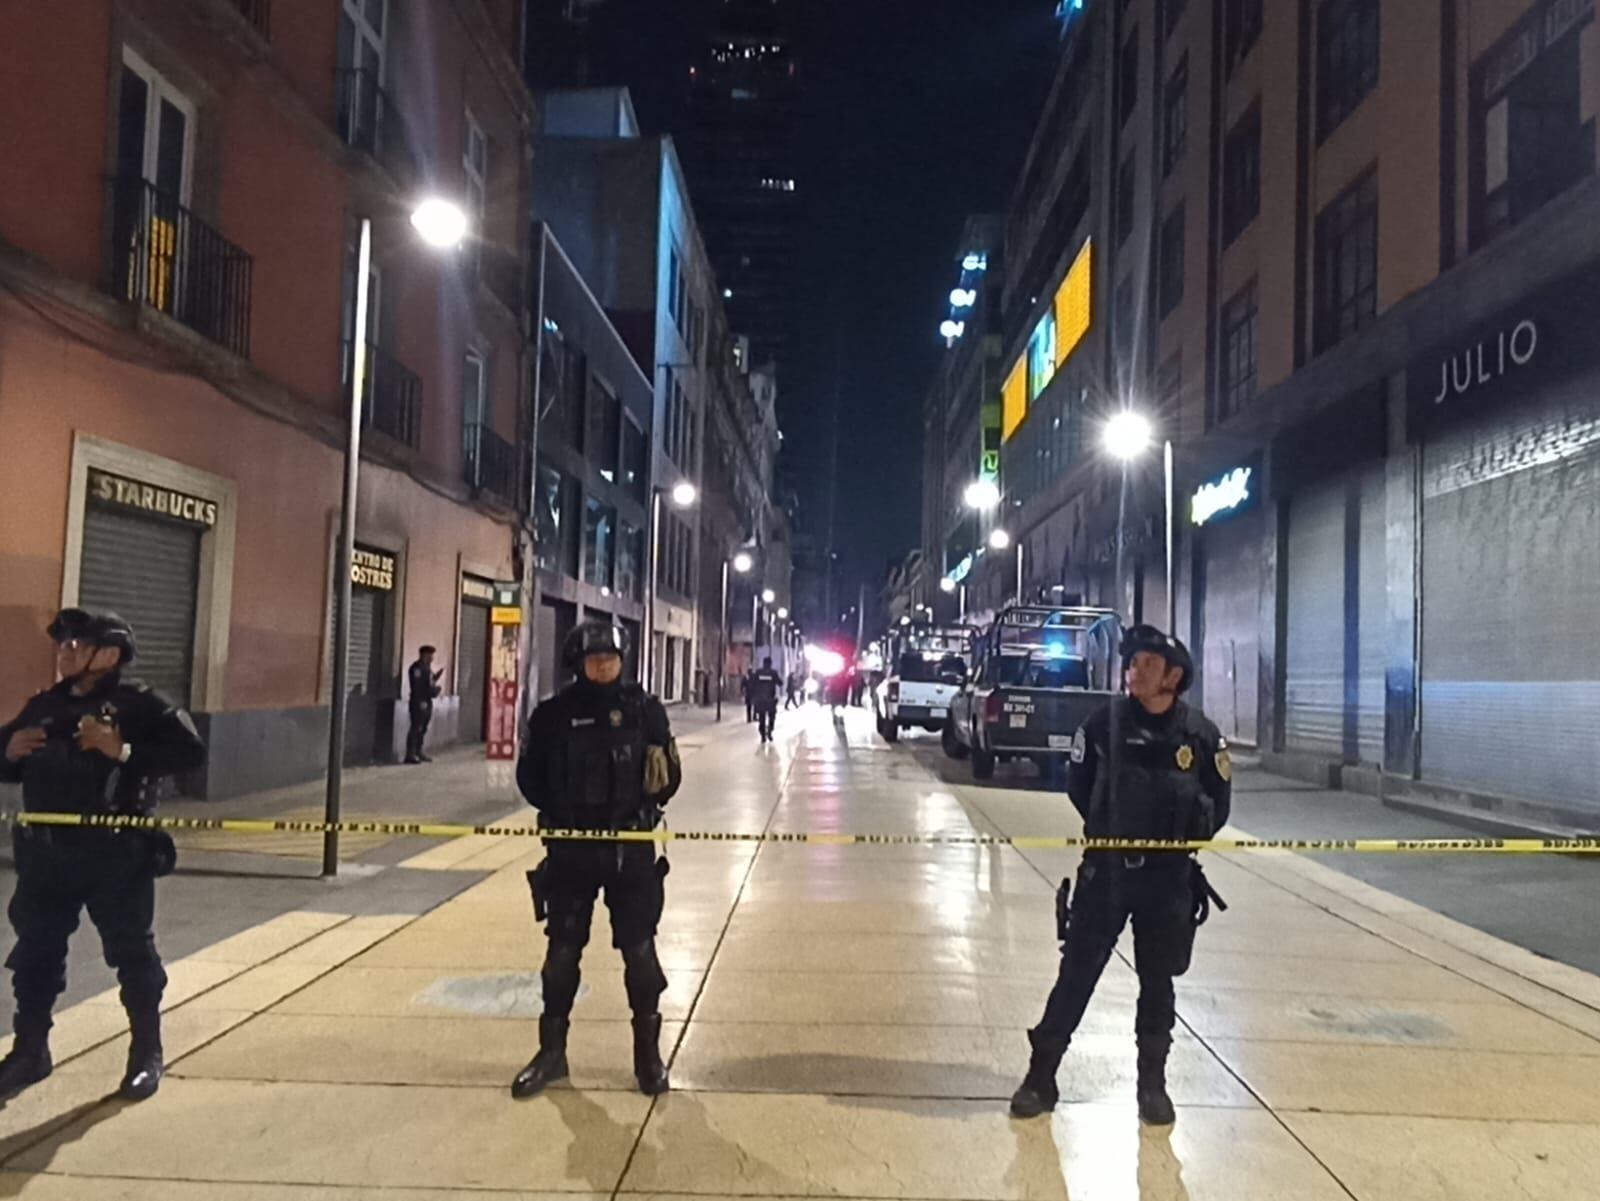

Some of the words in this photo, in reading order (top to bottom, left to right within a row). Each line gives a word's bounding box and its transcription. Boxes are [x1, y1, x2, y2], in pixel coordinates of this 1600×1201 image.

[1435, 319, 1537, 404] JULIO
[97, 474, 217, 525] STARBUCKS
[351, 564, 393, 591] OSTRES
